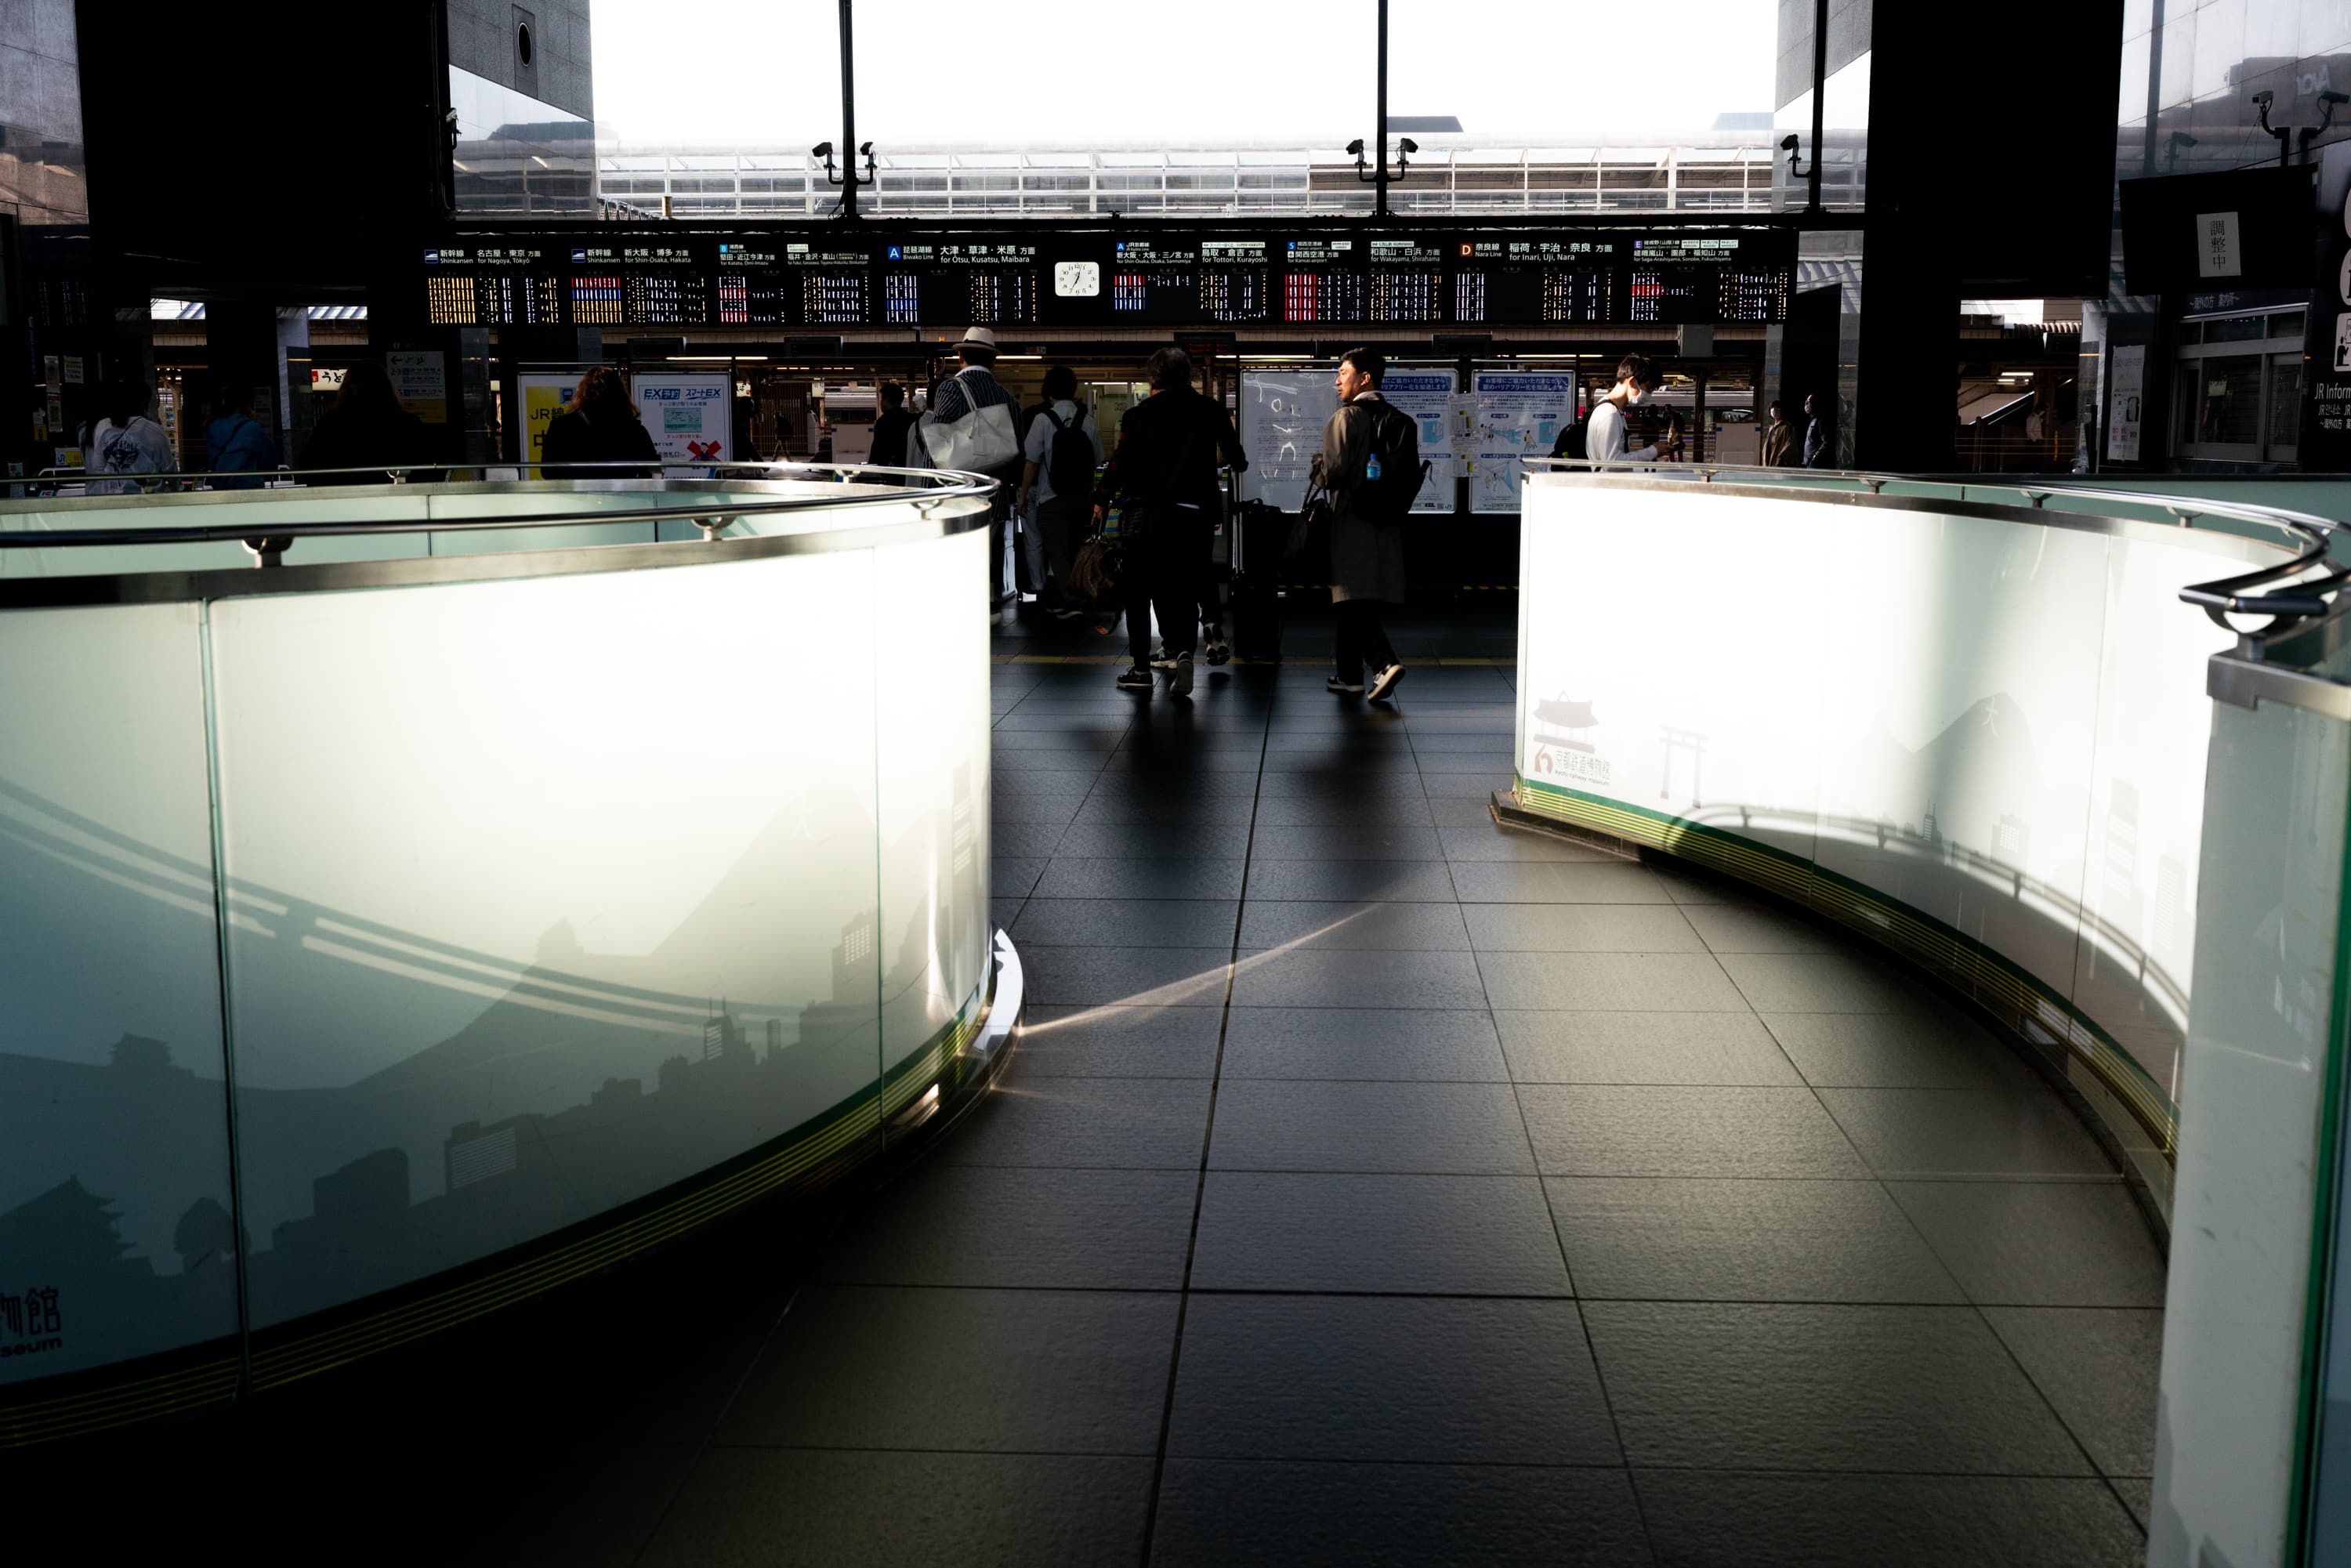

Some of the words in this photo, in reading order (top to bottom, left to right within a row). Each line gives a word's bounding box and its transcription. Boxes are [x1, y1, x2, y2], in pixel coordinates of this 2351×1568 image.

[940, 246, 1016, 255] 大津・草津・米原
[1462, 245, 1471, 255] D
[1509, 243, 1591, 252] 稲荷・宇治・奈良
[2211, 221, 2226, 270] 調整中
[890, 248, 898, 257] A
[644, 389, 680, 400] EX予約
[2315, 383, 2324, 400] JR
[531, 407, 564, 420] JR線
